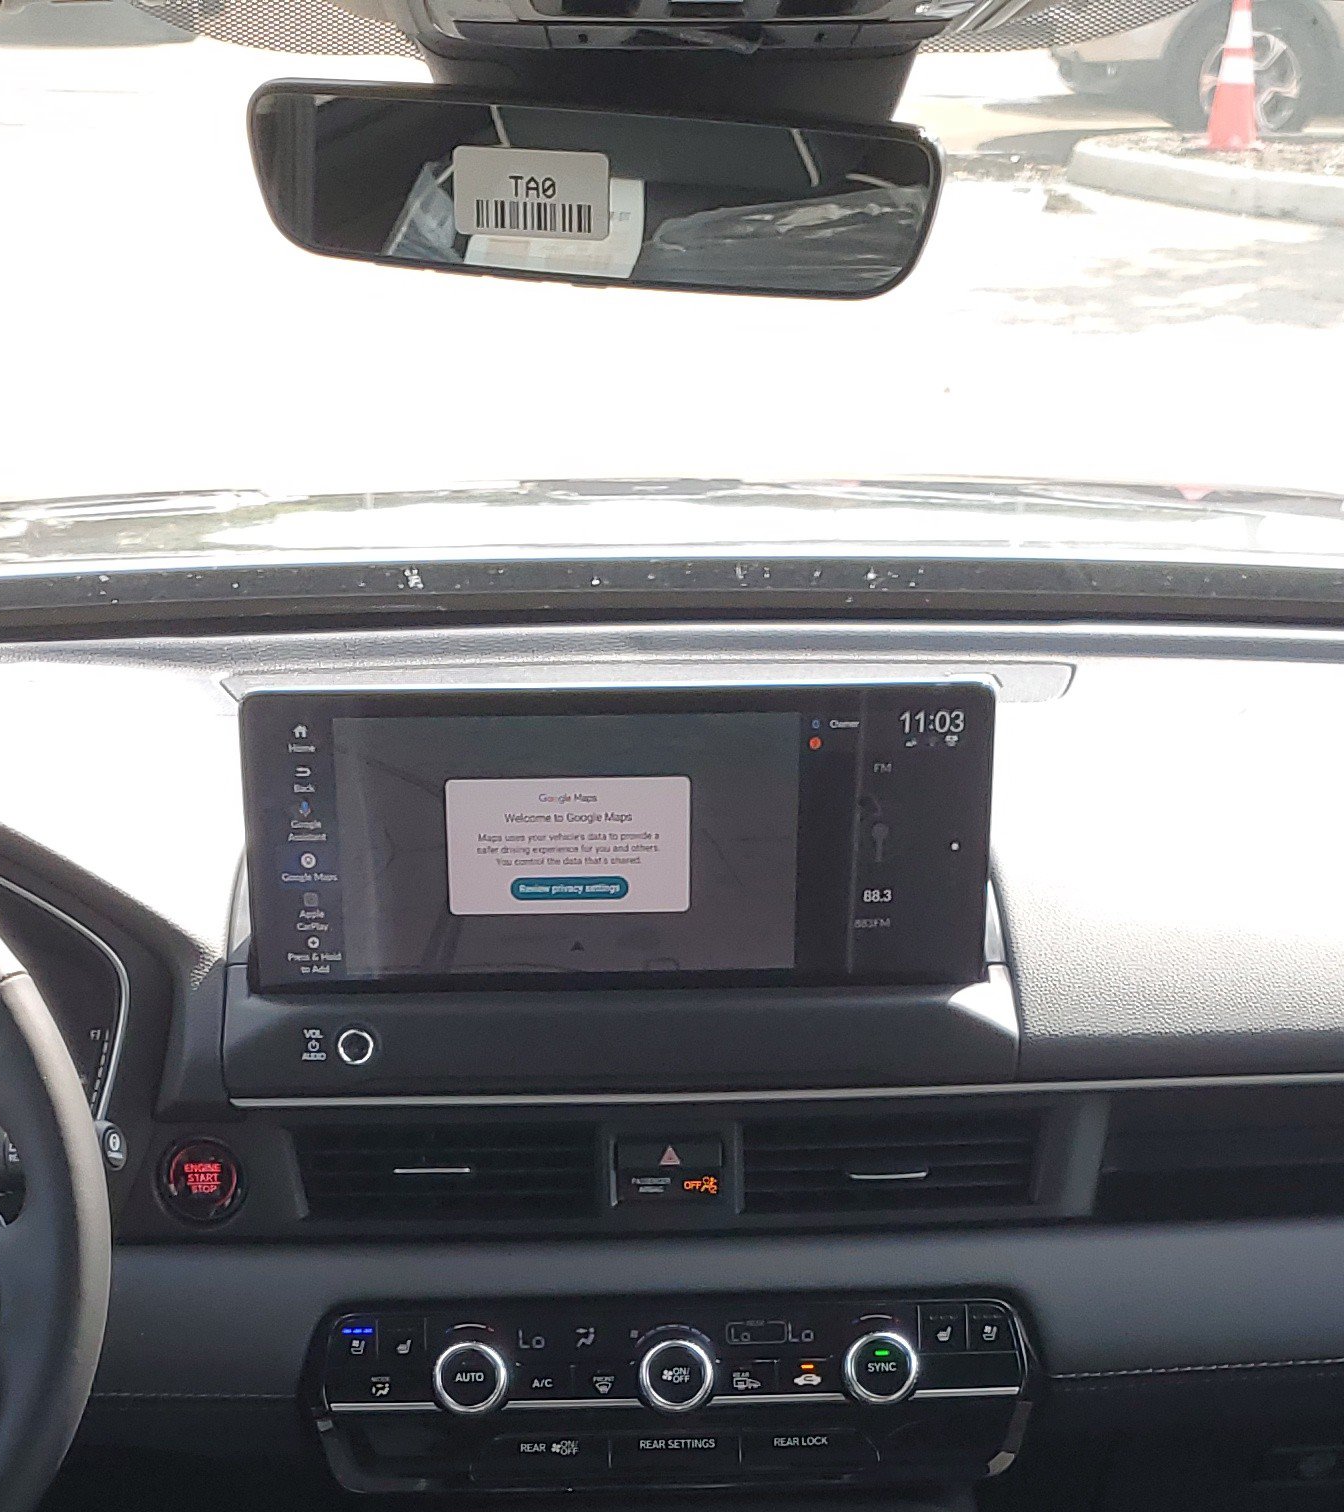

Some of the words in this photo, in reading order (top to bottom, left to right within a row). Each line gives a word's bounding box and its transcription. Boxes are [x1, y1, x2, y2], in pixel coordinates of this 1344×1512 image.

[899, 709, 966, 734] 11:03
[538, 793, 572, 805] Google
[504, 812, 552, 823] Welcome
[553, 813, 564, 823] to
[566, 812, 603, 825] Google
[604, 811, 633, 823] Maps
[863, 889, 892, 902] 88.3
[303, 1028, 324, 1039] VOL
[187, 1173, 219, 1182] START
[191, 1184, 219, 1194] STOP
[683, 1180, 702, 1190] OFF
[867, 1361, 898, 1374] SYNC
[454, 1371, 485, 1384] AUTO
[531, 1376, 555, 1390] A/C
[671, 1374, 691, 1384] OFF
[519, 1442, 548, 1454] REAR
[639, 1438, 666, 1450] REAR
[666, 1437, 716, 1450] SETTINGS
[773, 1436, 801, 1448] REAR
[801, 1435, 829, 1447] LOCK
